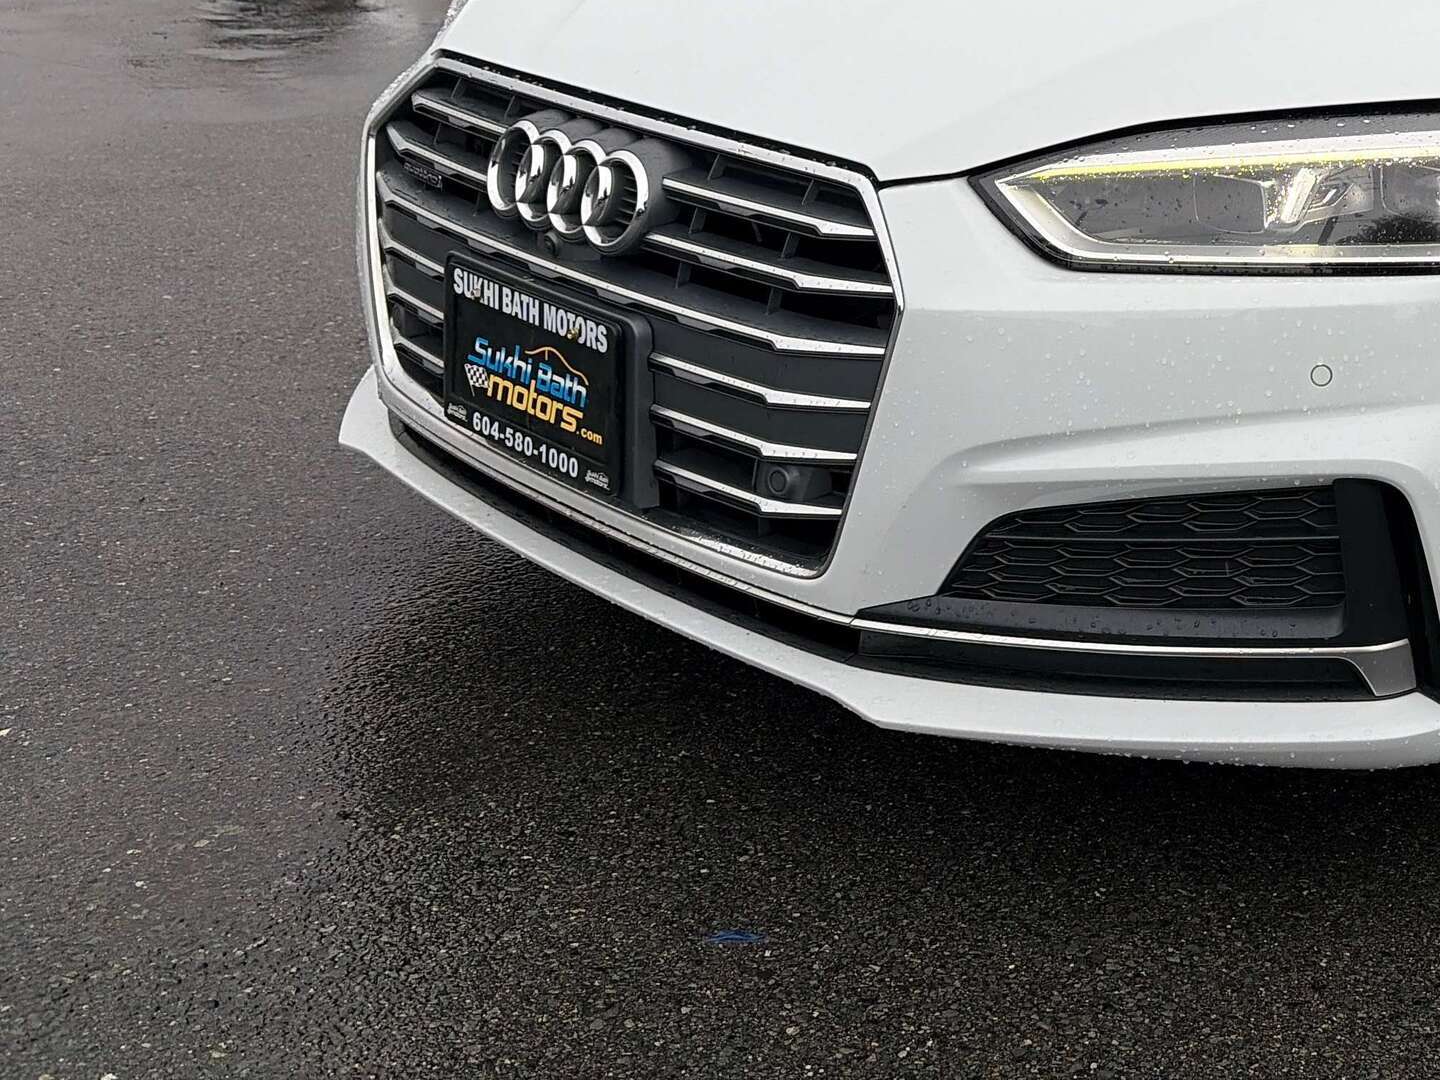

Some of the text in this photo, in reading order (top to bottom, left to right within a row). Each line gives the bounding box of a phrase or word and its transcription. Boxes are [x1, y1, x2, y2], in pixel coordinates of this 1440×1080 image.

[453, 267, 608, 353] SUKHI BATH MOTORS
[467, 336, 589, 409] Sukhi Bath
[472, 411, 579, 478] 604-580-1000
